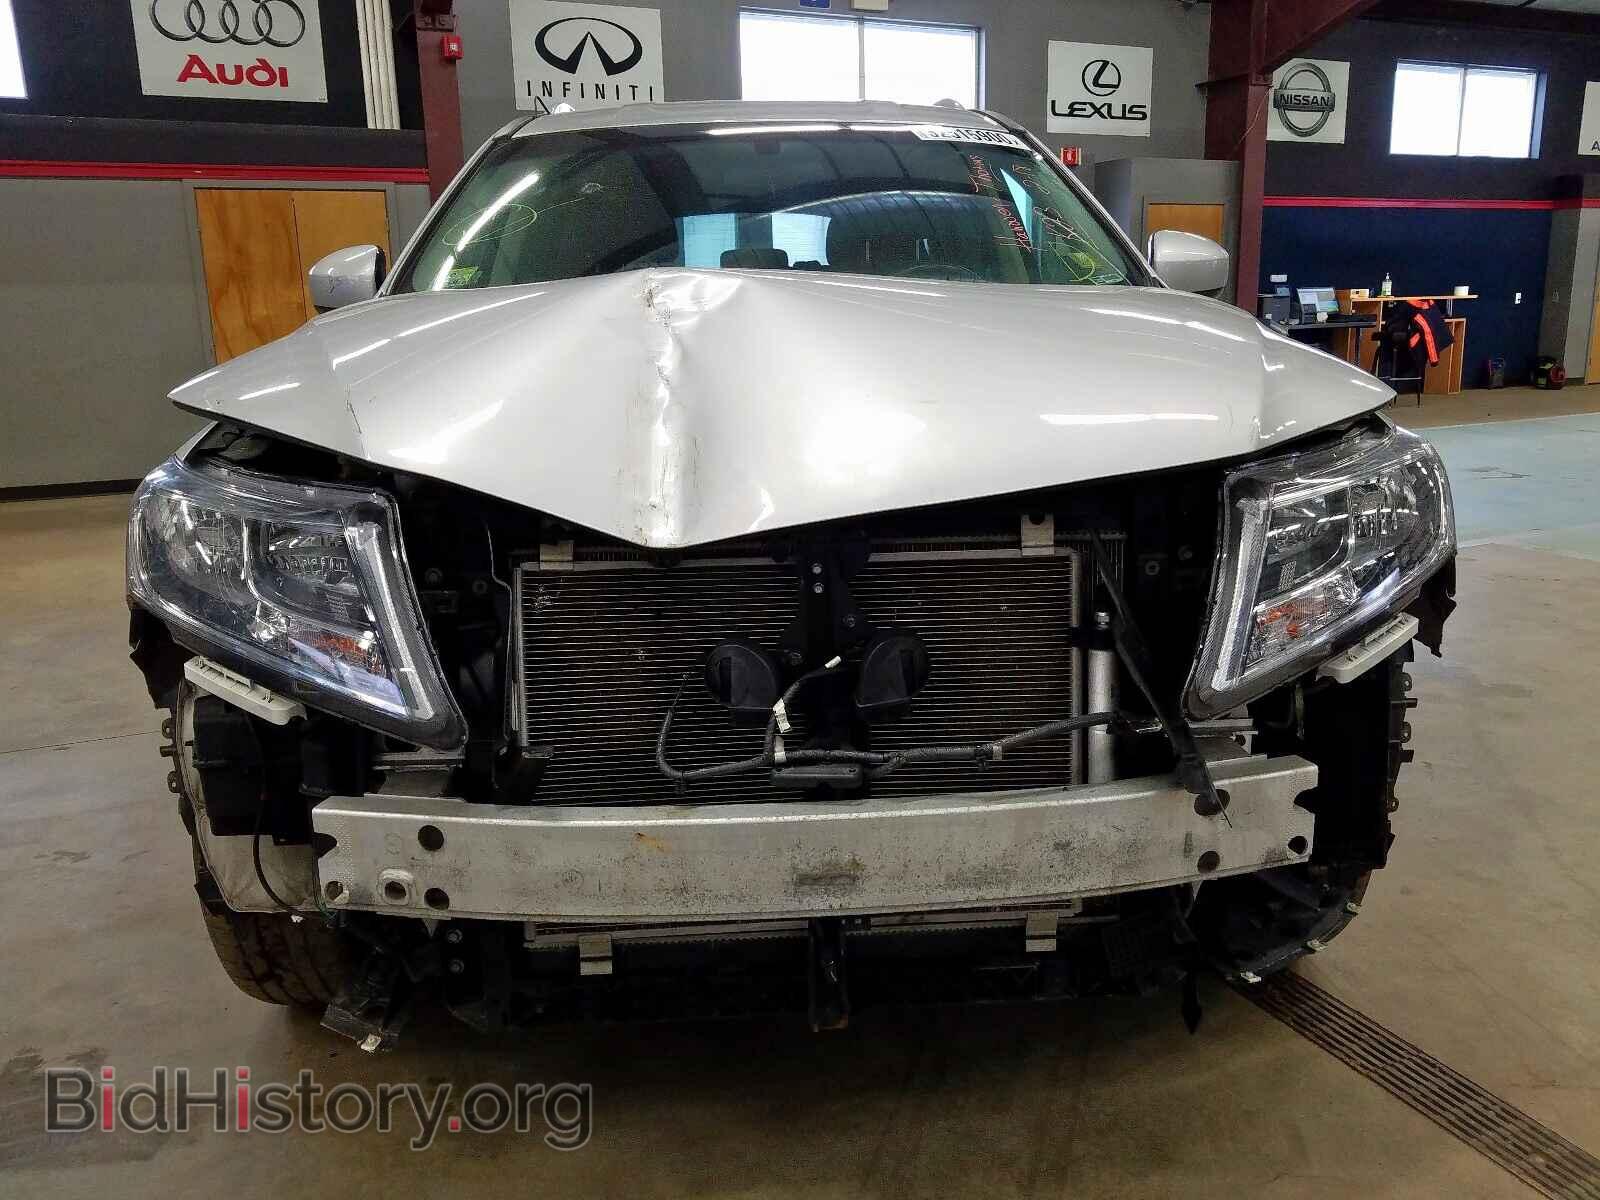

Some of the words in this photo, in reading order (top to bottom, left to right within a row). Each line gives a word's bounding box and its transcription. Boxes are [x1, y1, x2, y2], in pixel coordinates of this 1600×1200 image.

[177, 54, 289, 88] Audi
[527, 80, 653, 102] INFINITI
[1280, 94, 1330, 107] NISSAN
[1051, 100, 1148, 121] LEXUS
